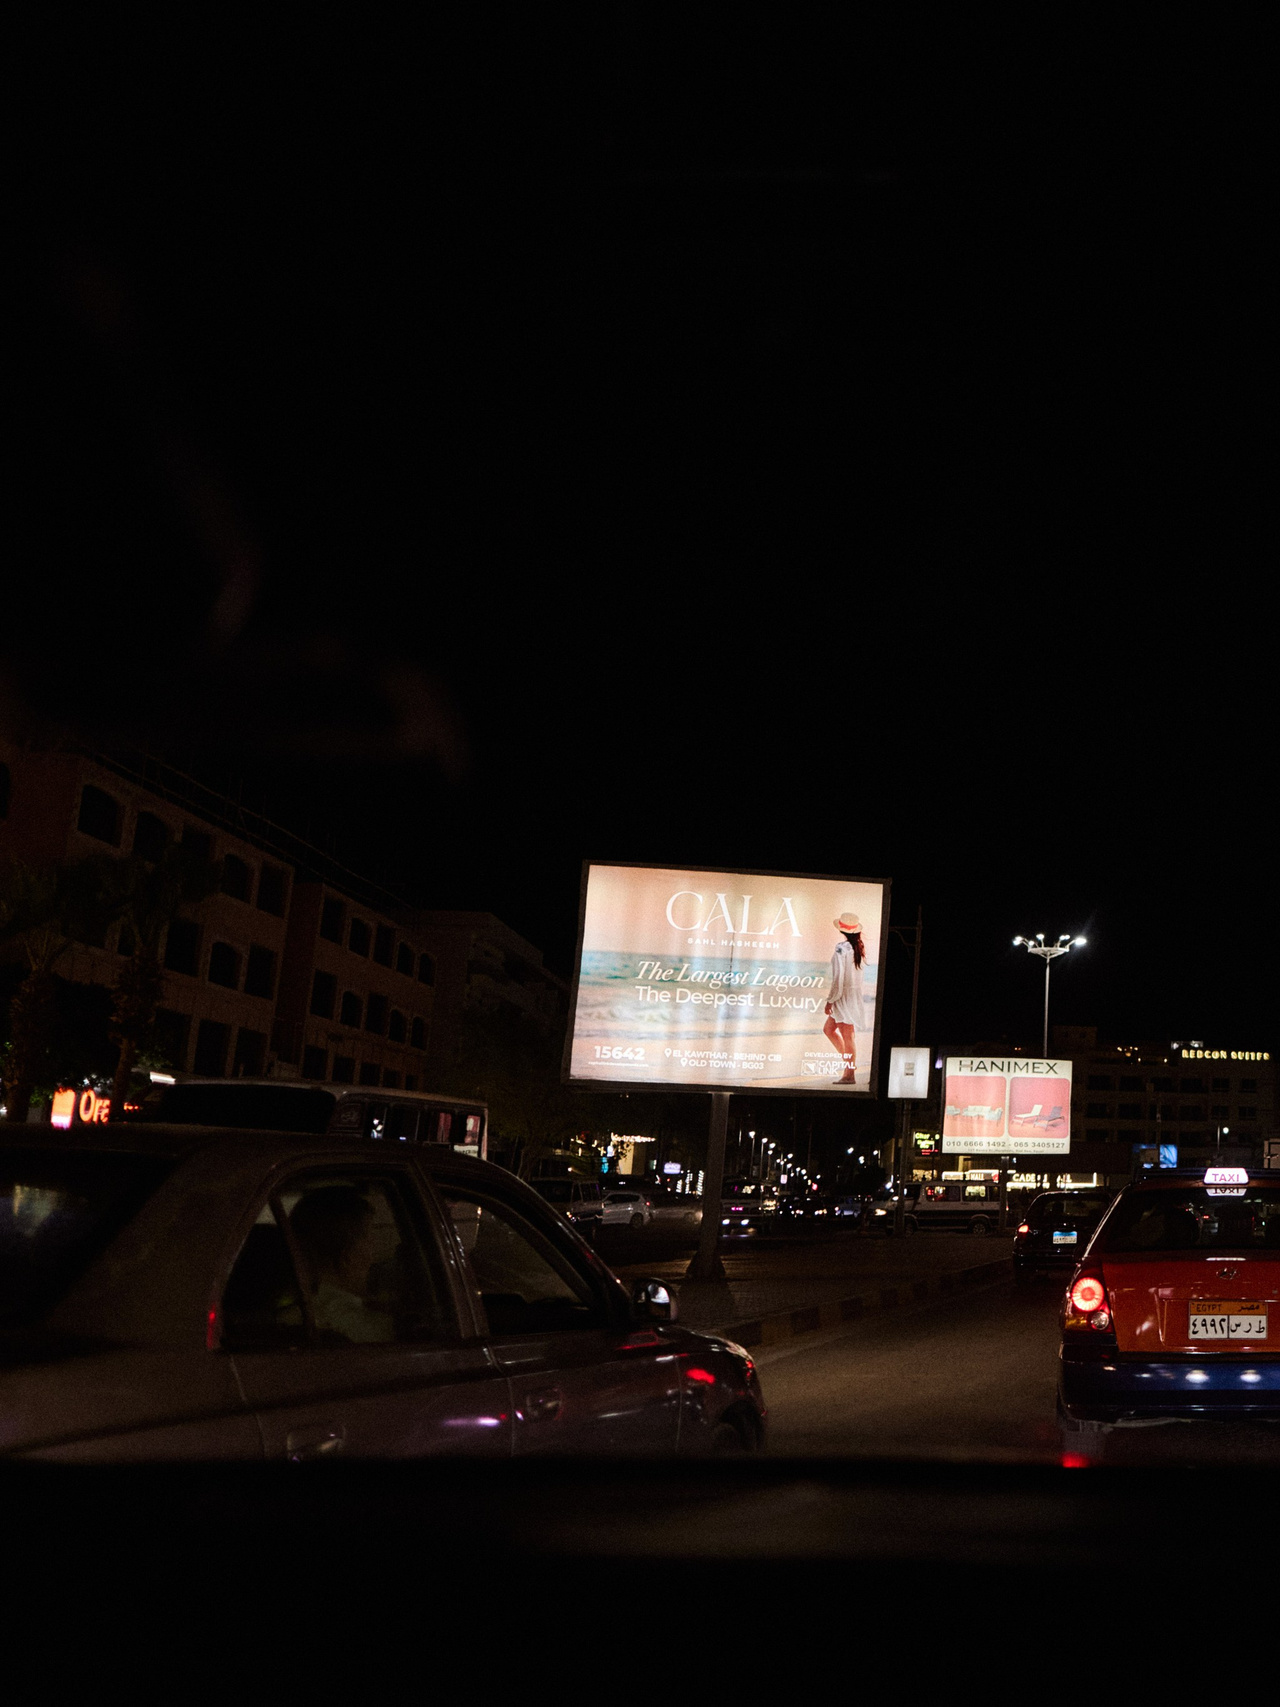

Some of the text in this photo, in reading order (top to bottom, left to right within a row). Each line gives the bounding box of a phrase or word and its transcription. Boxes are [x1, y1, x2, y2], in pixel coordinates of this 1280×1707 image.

[665, 891, 803, 937] CALA
[687, 938, 716, 946] SAHL
[635, 961, 824, 992] The Largest Lagoon
[635, 985, 823, 1013] The Deepest Luxury
[594, 1045, 646, 1060] 15642
[672, 1049, 683, 1057] EL
[684, 1050, 728, 1060] KAWTHAR
[734, 1052, 767, 1061] BEHIND
[1181, 1049, 1227, 1059] REDCON
[688, 1059, 707, 1067] OLD
[709, 1060, 736, 1069] TOWN
[819, 1060, 856, 1070] CAPITAL
[959, 1060, 1058, 1074] HANIMEX
[818, 1067, 839, 1075] LINK
[1031, 1141, 1066, 1149] 3405127
[1212, 1173, 1240, 1182] TAXI
[1196, 1303, 1222, 1312] EGYPT
[1238, 1304, 1260, 1312] مصر
